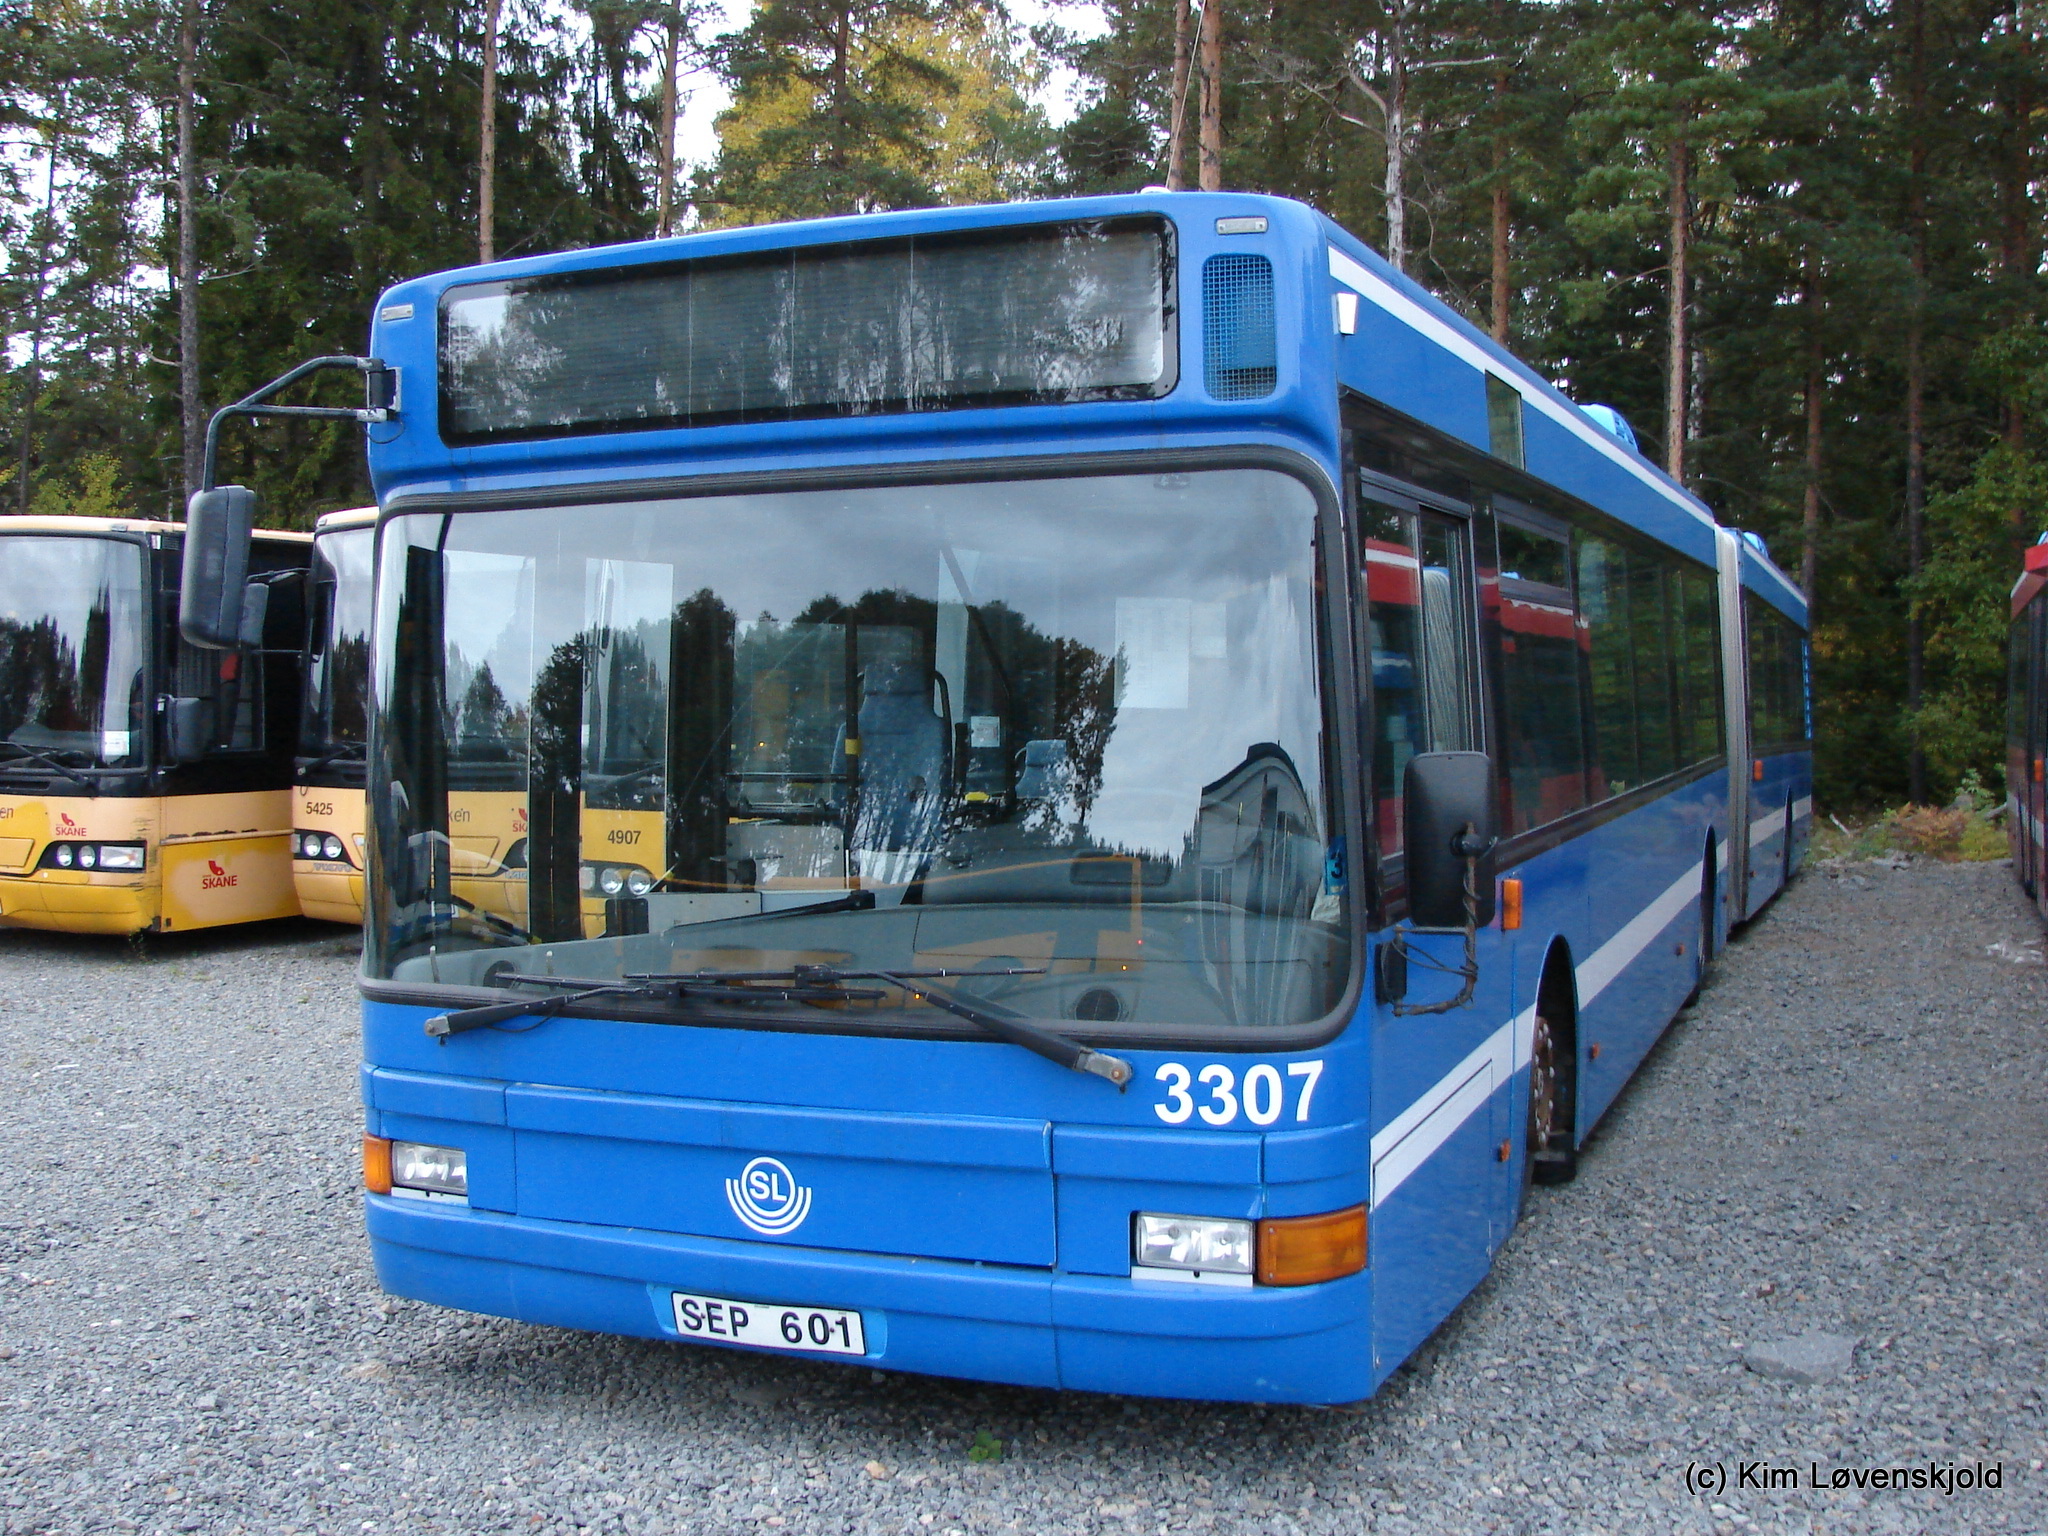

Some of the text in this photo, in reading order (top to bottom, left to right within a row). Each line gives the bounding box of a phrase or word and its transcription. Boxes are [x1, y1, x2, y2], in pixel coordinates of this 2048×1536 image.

[306, 802, 333, 815] 5425
[607, 830, 642, 845] 4907
[1153, 1059, 1324, 1126] 3307
[749, 1170, 788, 1202] SL
[681, 1299, 851, 1348] SEP 601
